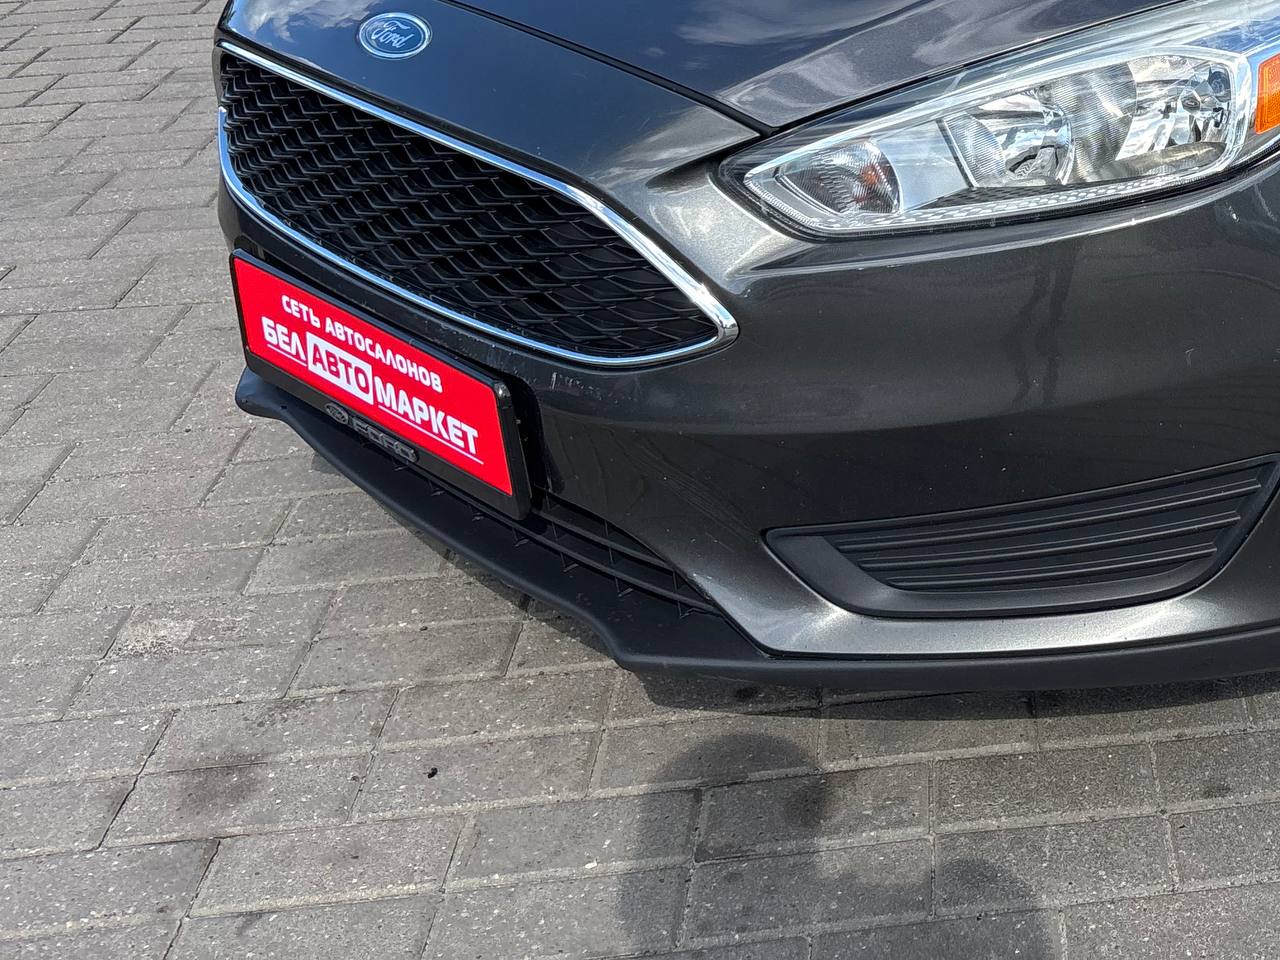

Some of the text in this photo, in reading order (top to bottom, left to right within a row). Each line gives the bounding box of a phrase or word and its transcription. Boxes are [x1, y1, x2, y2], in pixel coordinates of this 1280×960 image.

[371, 20, 415, 48] Ford
[281, 294, 443, 393] СЕТЬ АВТОСАЛОНОВ
